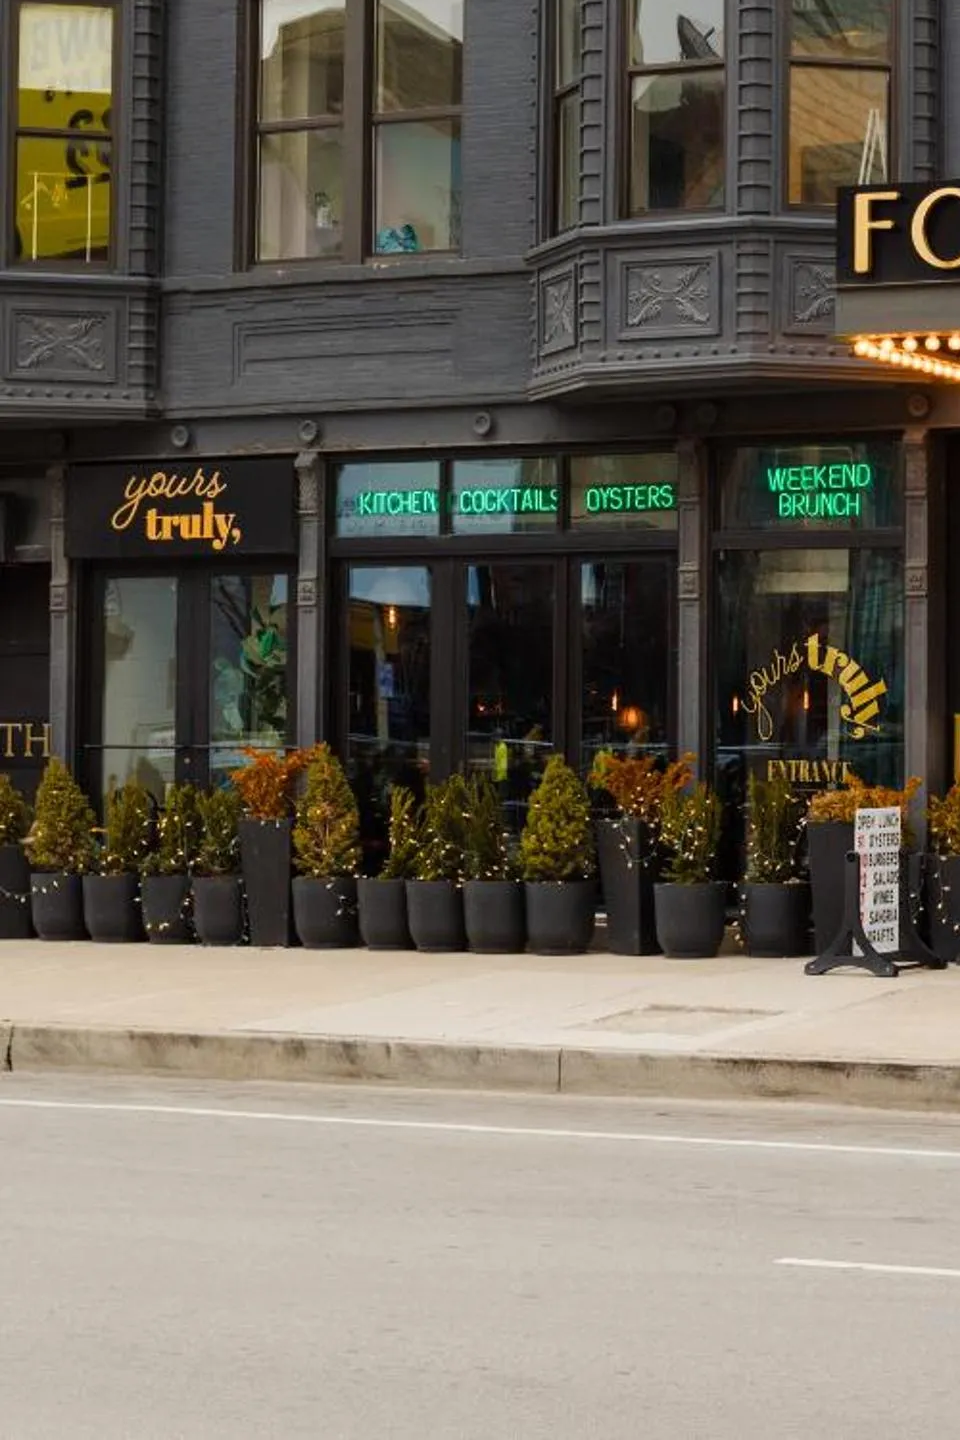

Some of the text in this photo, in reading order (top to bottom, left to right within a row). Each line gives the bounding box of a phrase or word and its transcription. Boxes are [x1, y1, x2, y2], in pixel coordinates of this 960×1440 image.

[767, 463, 871, 492] WEEKEND
[111, 467, 228, 530] yours
[359, 484, 673, 515] KITCHEN COCKTAILS OYSTERS
[778, 491, 861, 517] BRUNCH
[143, 500, 241, 550] truly,
[741, 643, 804, 741] yours
